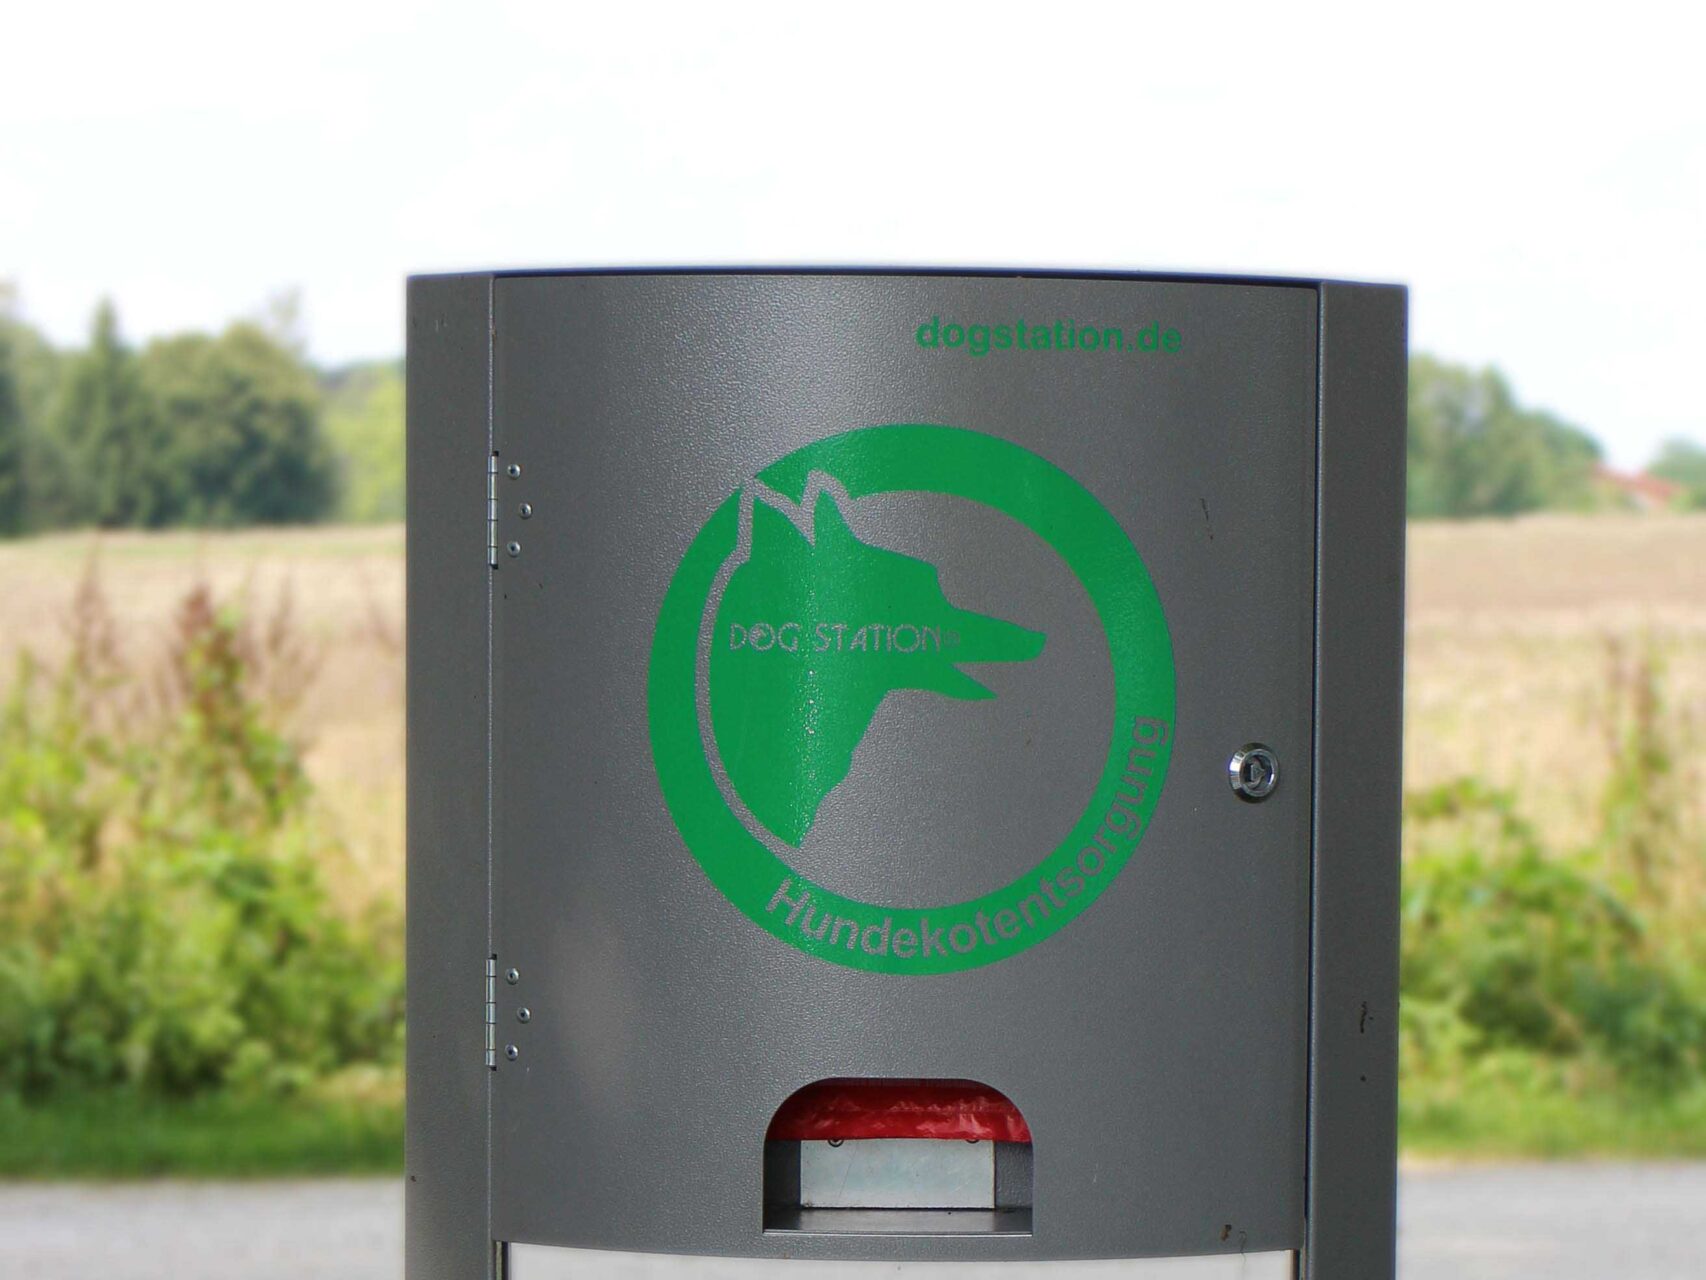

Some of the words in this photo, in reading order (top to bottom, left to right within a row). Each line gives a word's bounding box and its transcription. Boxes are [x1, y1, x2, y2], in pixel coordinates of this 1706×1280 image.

[915, 315, 1182, 357] dogstation.de
[729, 622, 801, 652] DOG
[765, 715, 1169, 959] Hundekotentsorgung
